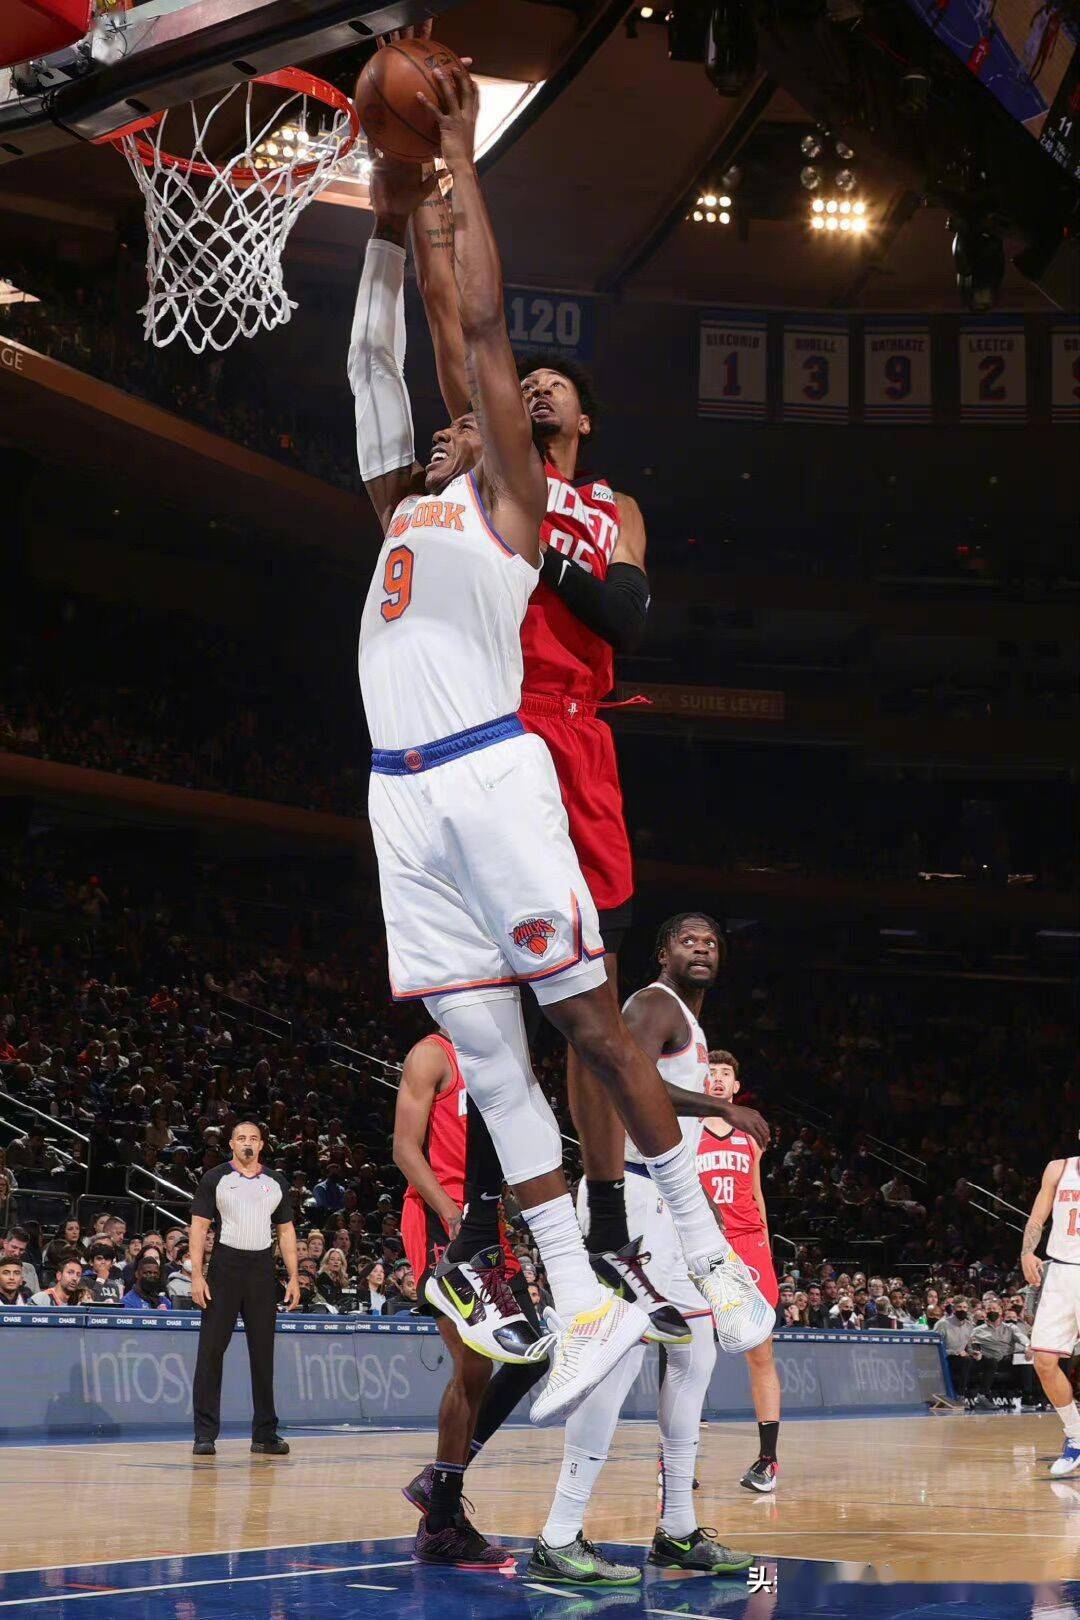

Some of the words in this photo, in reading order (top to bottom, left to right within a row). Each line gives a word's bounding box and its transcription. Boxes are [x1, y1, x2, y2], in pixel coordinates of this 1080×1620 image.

[510, 297, 581, 345] 120
[722, 351, 741, 397] 1
[802, 355, 830, 400] 3
[884, 355, 913, 399] 9
[977, 355, 1007, 400] 2
[546, 477, 619, 566] OCKETS
[381, 544, 415, 623] 9
[680, 694, 726, 710] SUITE
[730, 697, 776, 713] LEVE
[695, 1150, 750, 1174] ROCKETS
[711, 1176, 734, 1204] 28
[294, 1342, 410, 1409] Infosys
[851, 1348, 916, 1399] Infosys
